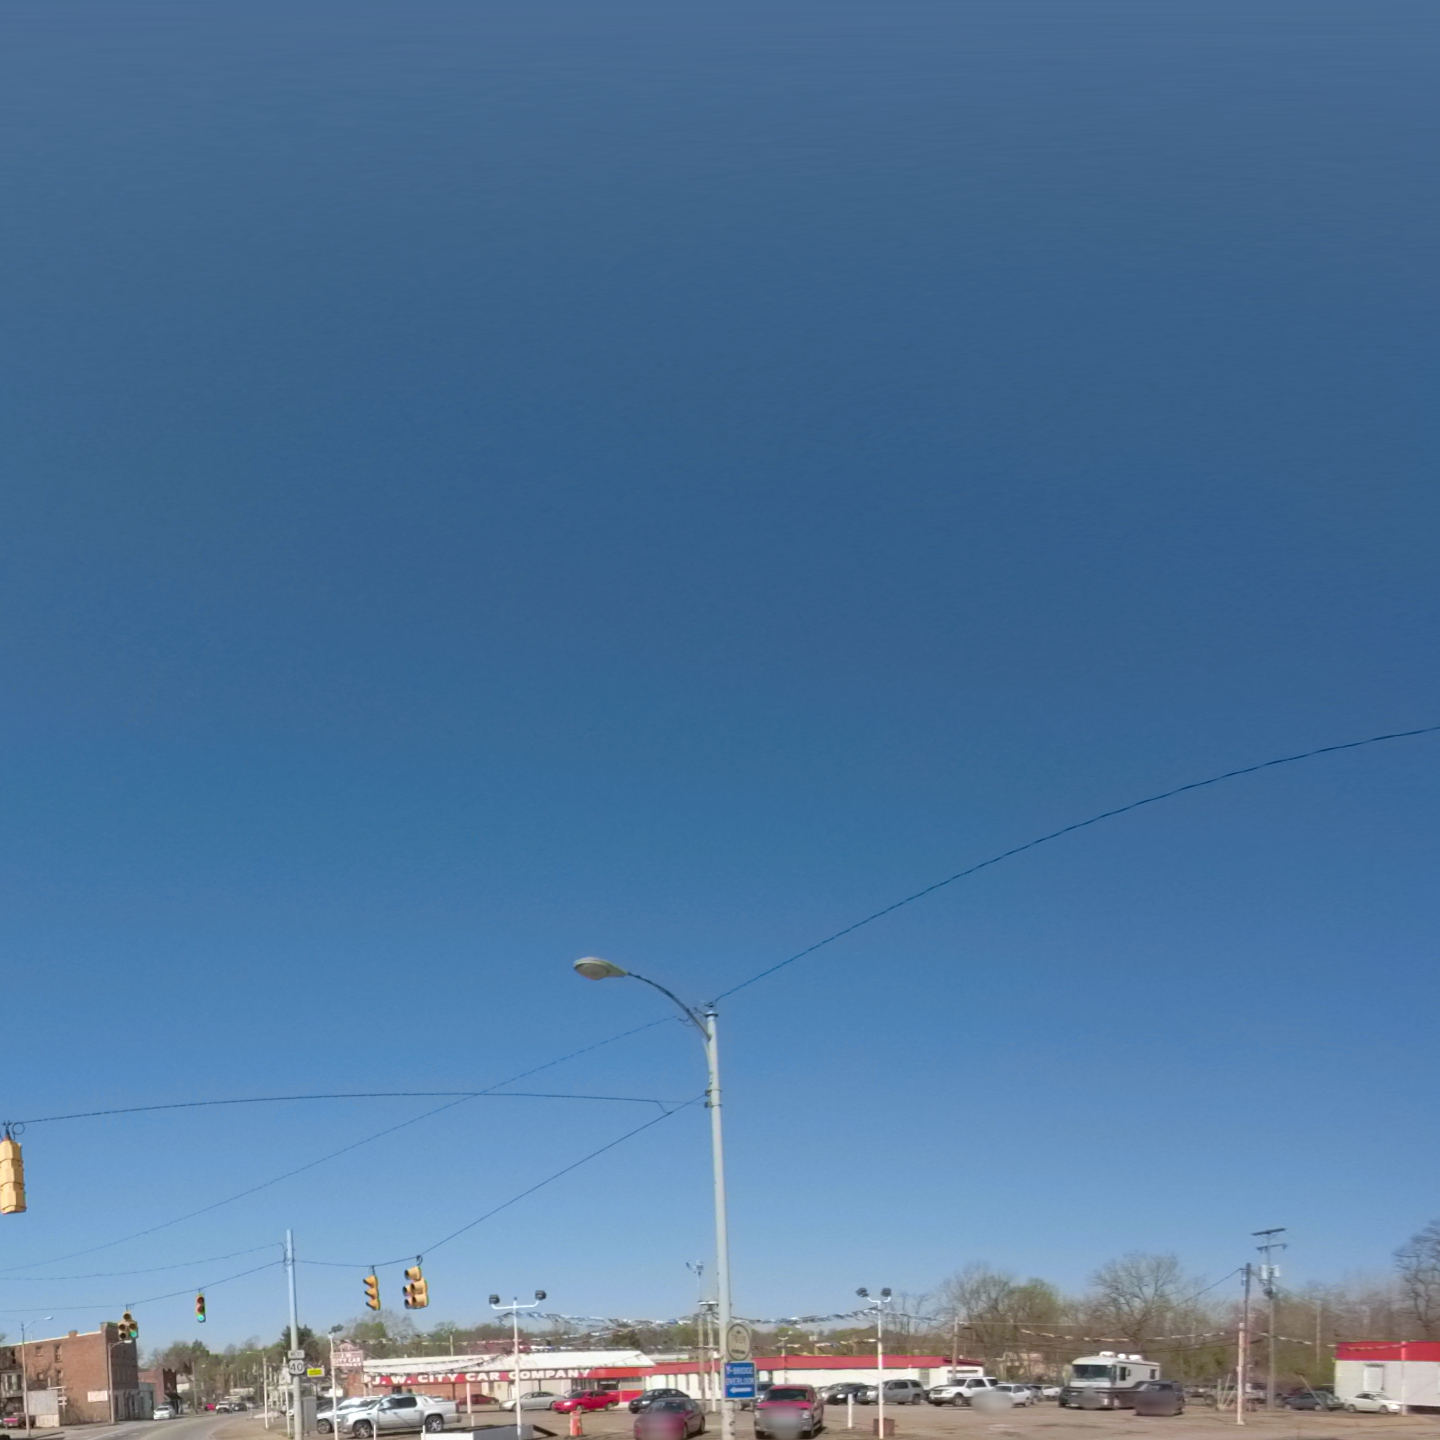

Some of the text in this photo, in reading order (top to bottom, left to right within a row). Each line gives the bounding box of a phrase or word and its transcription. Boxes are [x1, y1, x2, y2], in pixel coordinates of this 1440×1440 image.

[290, 1362, 304, 1373] 40
[372, 1369, 590, 1385] J. W. CITY CAR COMPANY
